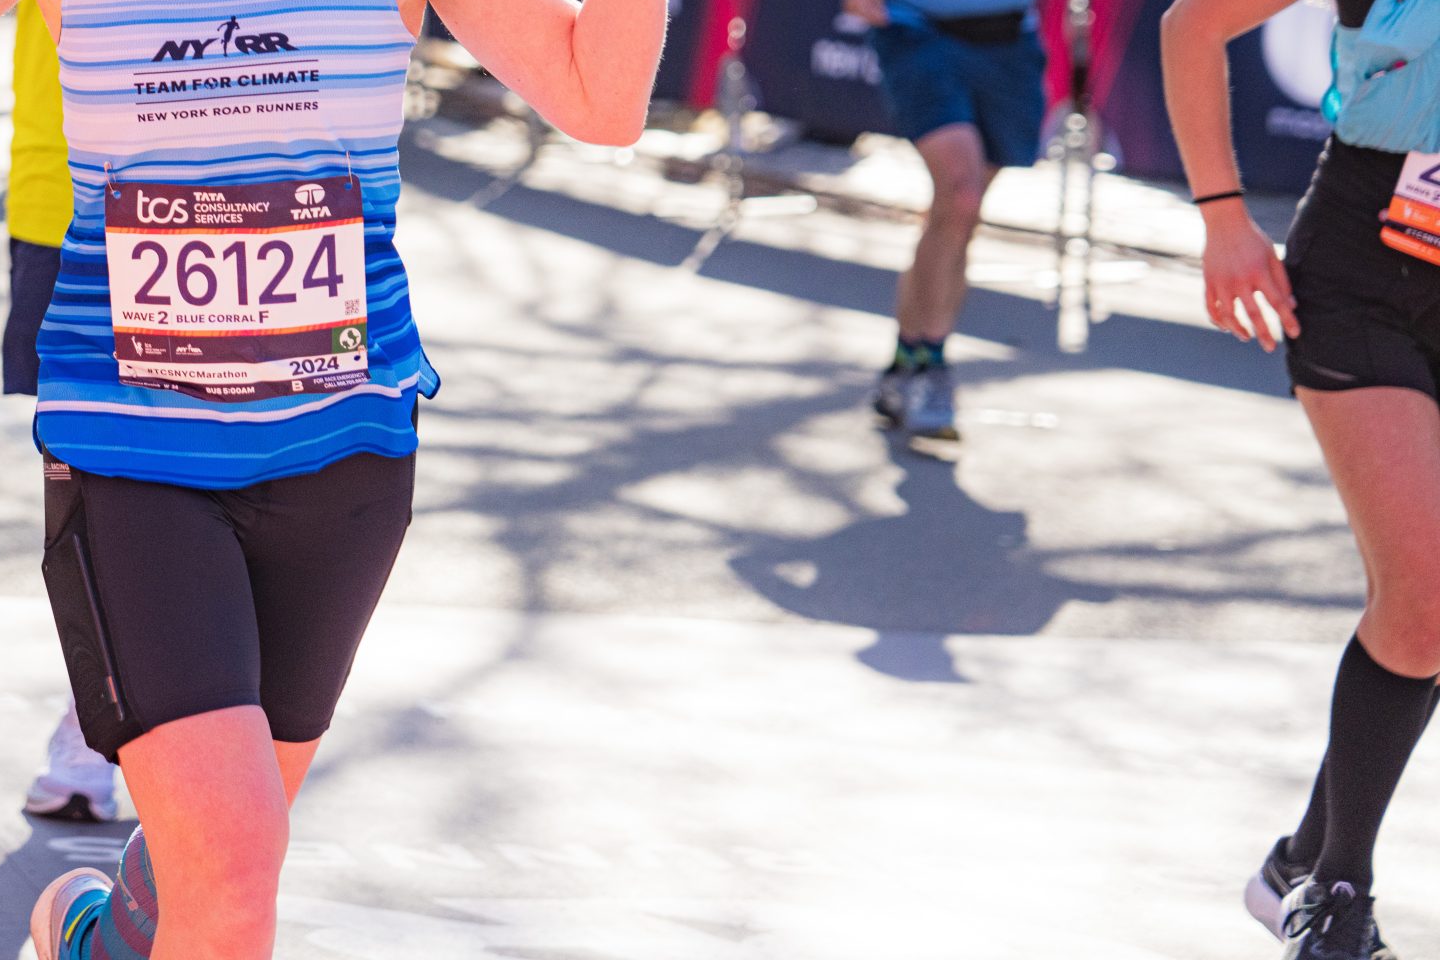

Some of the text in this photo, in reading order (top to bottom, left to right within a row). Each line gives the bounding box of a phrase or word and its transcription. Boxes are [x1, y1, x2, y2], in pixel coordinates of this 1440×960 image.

[134, 70, 320, 95] TEAM FOR CLIMATE
[137, 101, 320, 123] NEW YORK ROAD RUNNERS
[193, 192, 226, 202] TATA
[137, 190, 189, 224] tcs
[193, 202, 270, 214] CONSULTANCY
[290, 206, 332, 220] TATA
[194, 213, 244, 224] SERVICES
[131, 233, 344, 307] 26124
[122, 311, 269, 325] WAVE 2 BLUE CORRAL F
[289, 356, 340, 376] 2024
[147, 368, 248, 379] #TCSNYCMarathon
[205, 386, 255, 395] BUS 5:00AM
[291, 380, 304, 392] B
